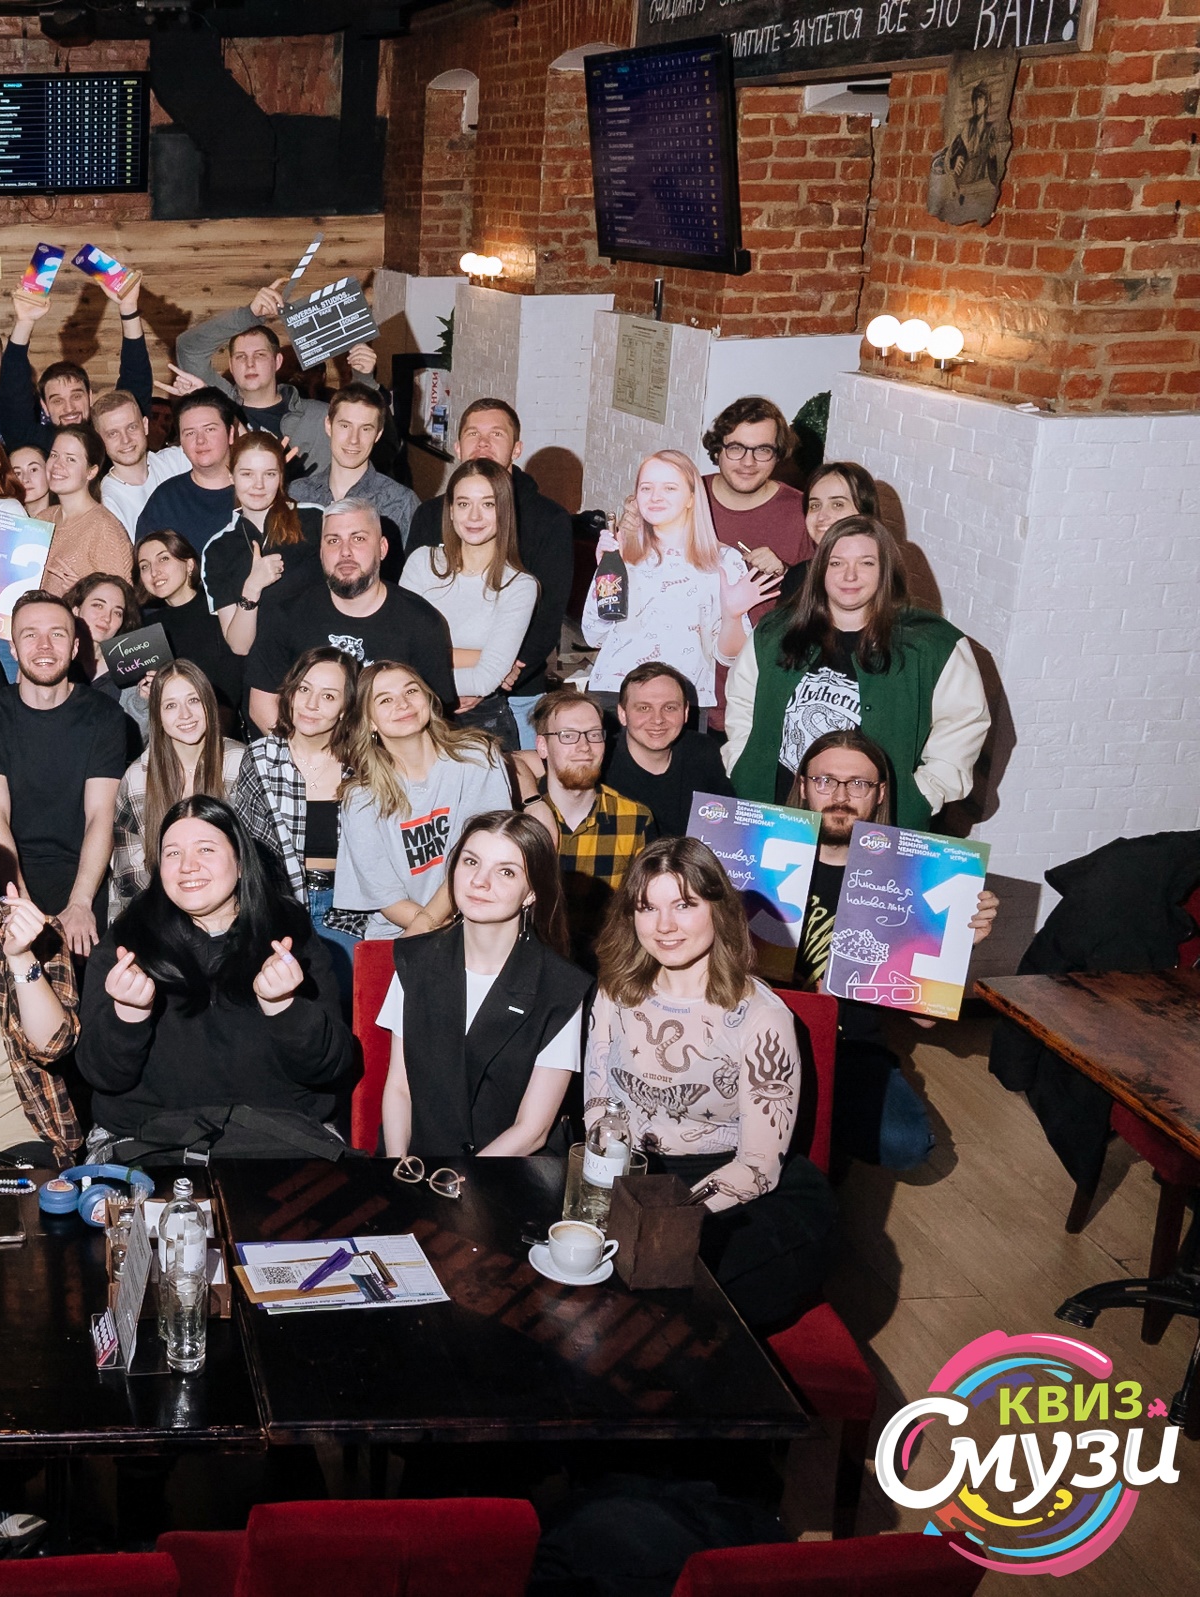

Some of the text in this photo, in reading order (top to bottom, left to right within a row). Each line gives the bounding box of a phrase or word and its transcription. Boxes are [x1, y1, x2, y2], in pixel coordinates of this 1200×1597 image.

[287, 305, 321, 323] UNIVERSAL
[108, 637, 150, 658] Только
[698, 806, 729, 819] Смузи
[735, 815, 775, 827] ЧЕМПИОНАТ
[401, 816, 450, 849] MNC
[859, 835, 892, 849] Смузи
[899, 840, 929, 850] ЗИМНИЙ
[406, 835, 448, 868] HRN
[898, 845, 941, 858] ЧЕМПИОНАТ
[910, 873, 985, 985] 1
[642, 1072, 673, 1083] amour
